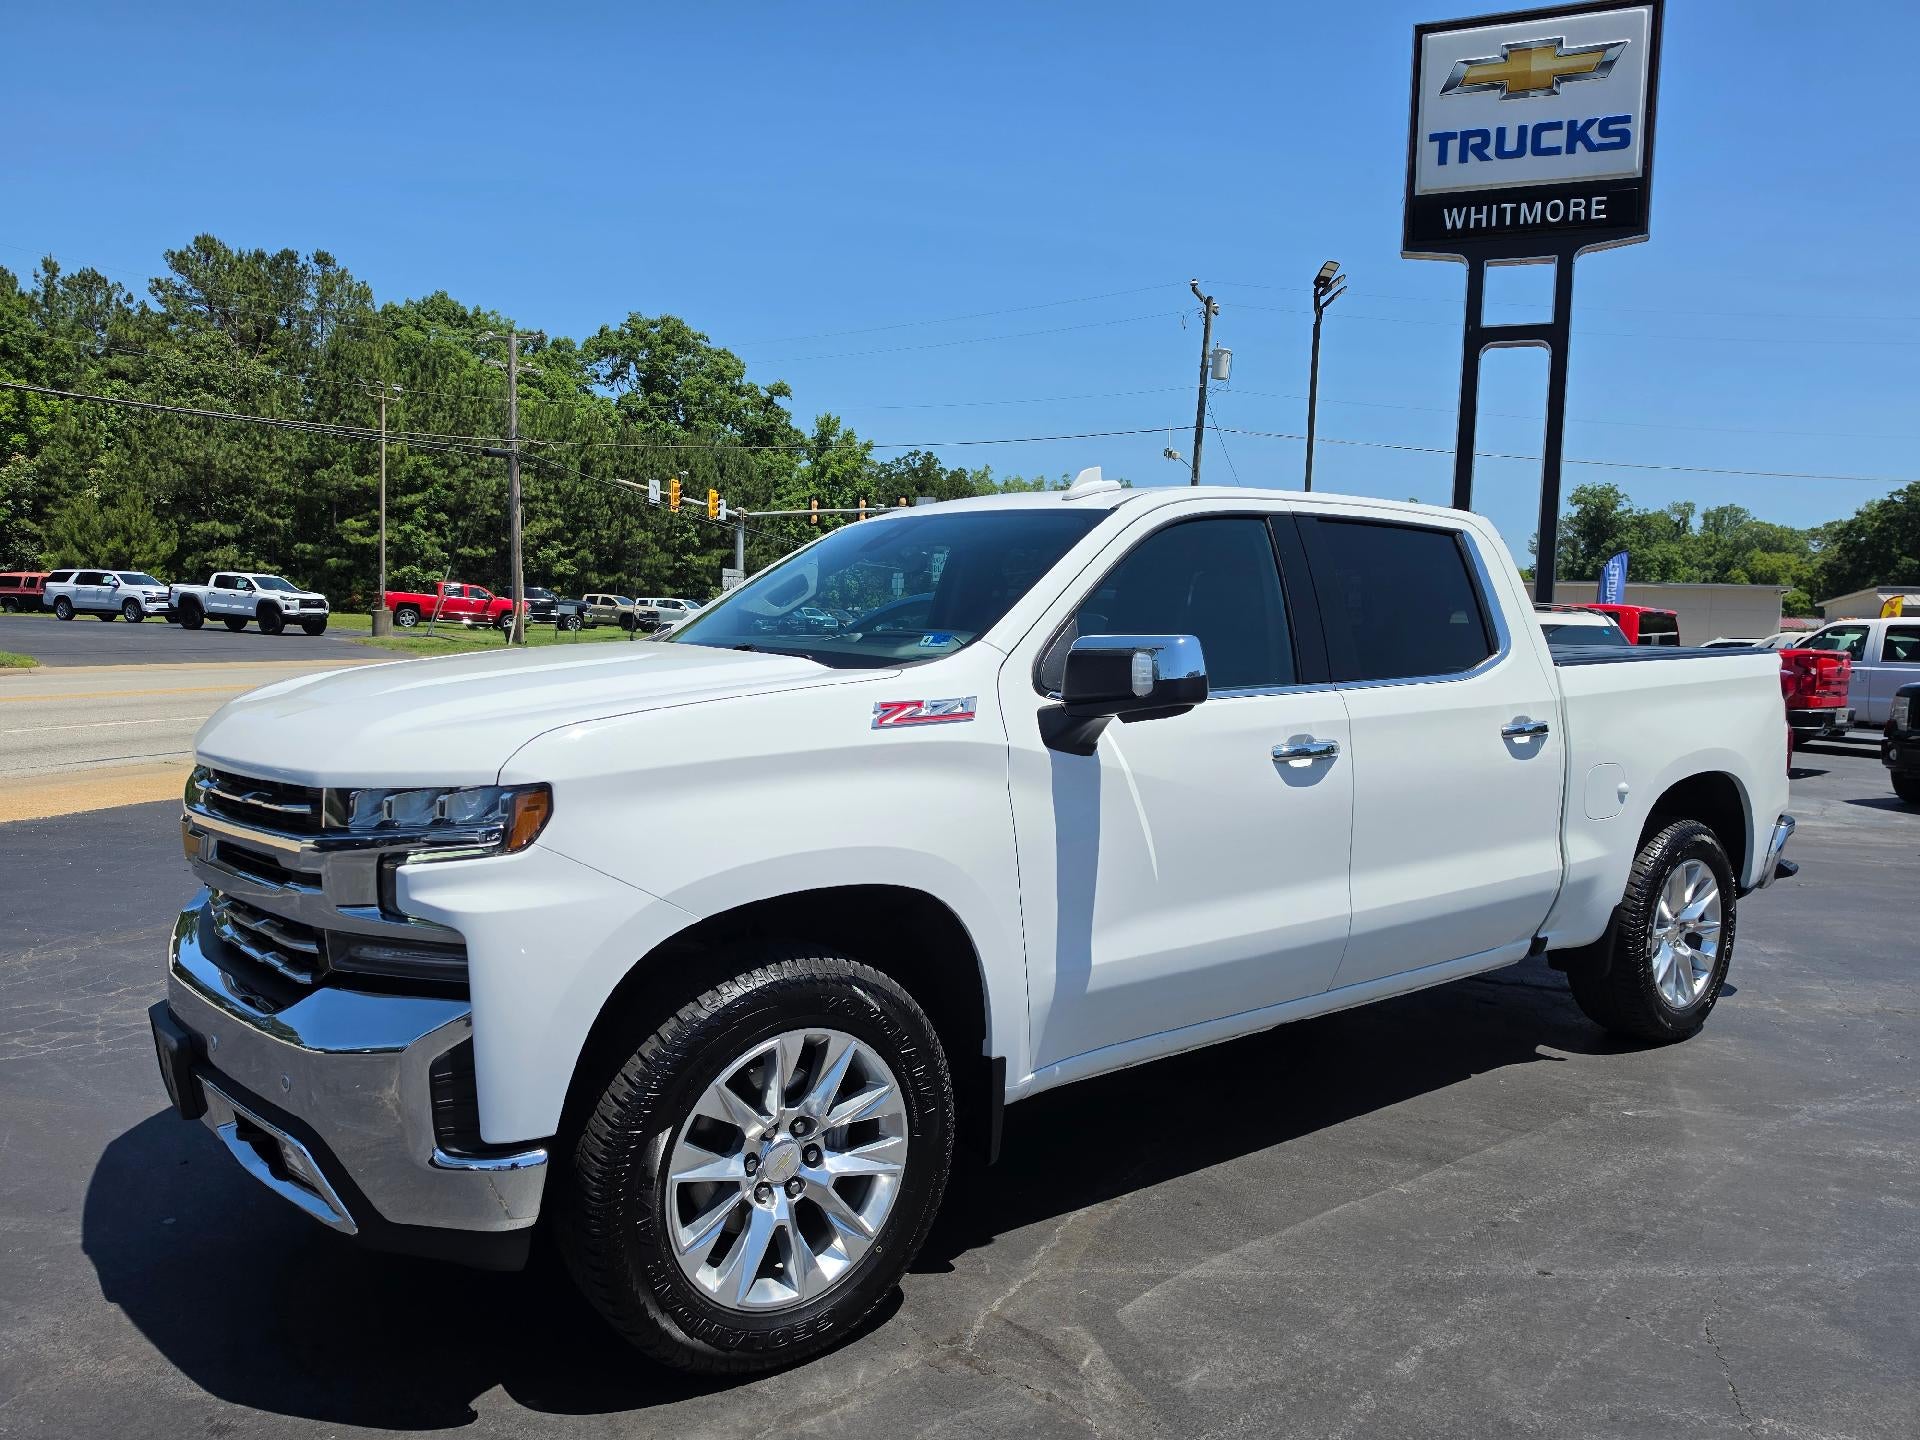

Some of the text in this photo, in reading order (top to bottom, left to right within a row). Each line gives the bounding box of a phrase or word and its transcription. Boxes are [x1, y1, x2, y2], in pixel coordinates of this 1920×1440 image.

[1429, 114, 1632, 166] TRUCKS
[1443, 196, 1608, 231] WHITMORE
[871, 696, 978, 730] Z71
[647, 1264, 835, 1350] GEOLANDAR
